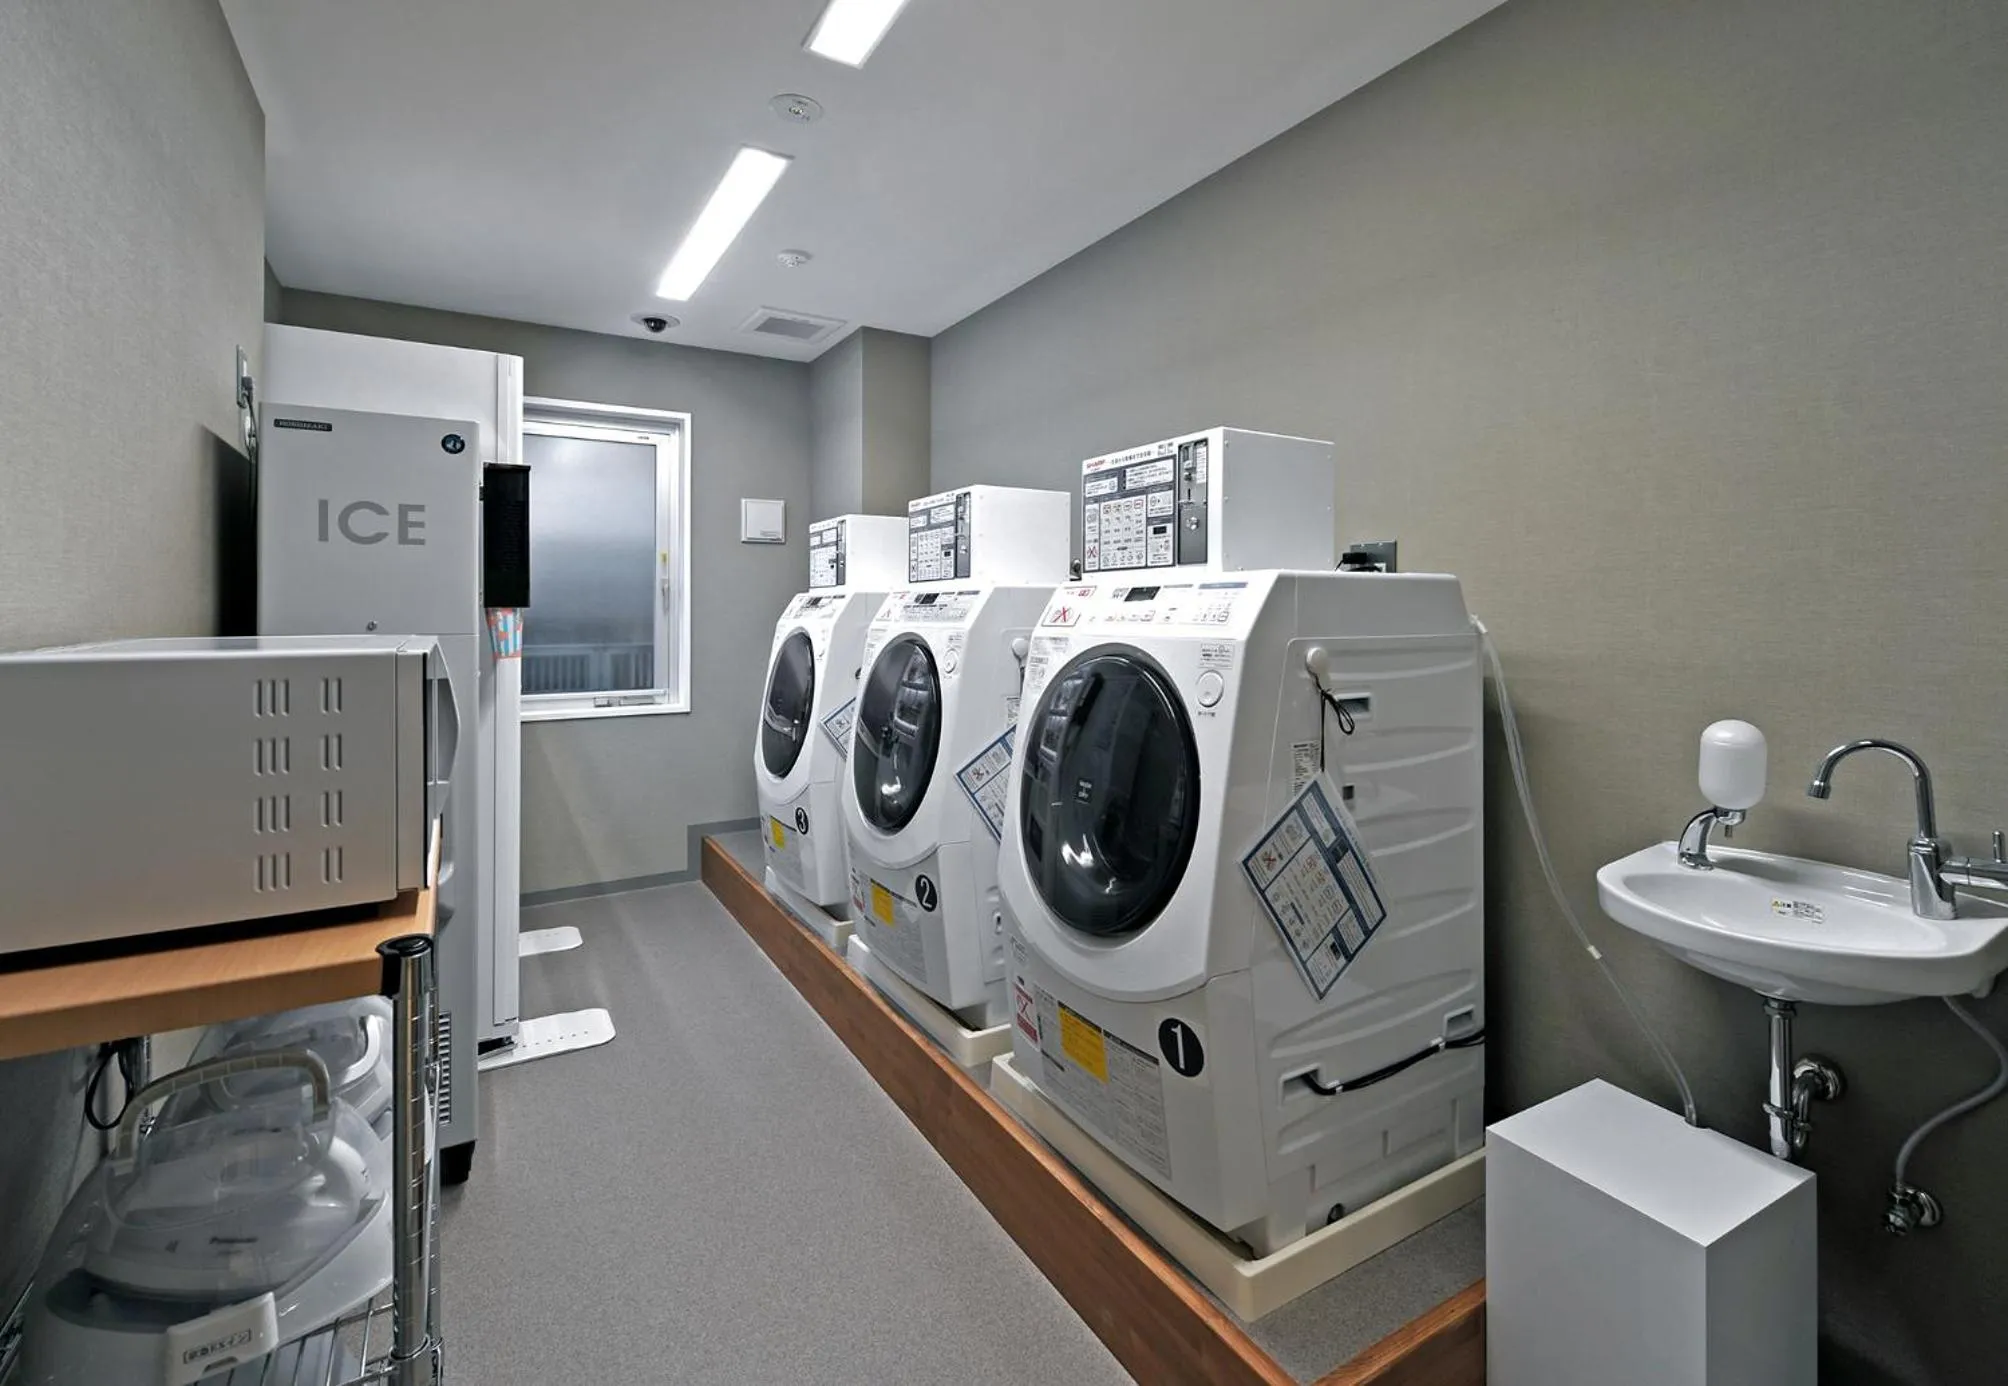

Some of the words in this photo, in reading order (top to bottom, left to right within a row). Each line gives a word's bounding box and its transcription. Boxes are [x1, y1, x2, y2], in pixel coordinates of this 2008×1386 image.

[318, 499, 426, 545] ICE
[797, 808, 806, 832] 3
[920, 878, 933, 909] 2
[1171, 1024, 1185, 1069] 1
